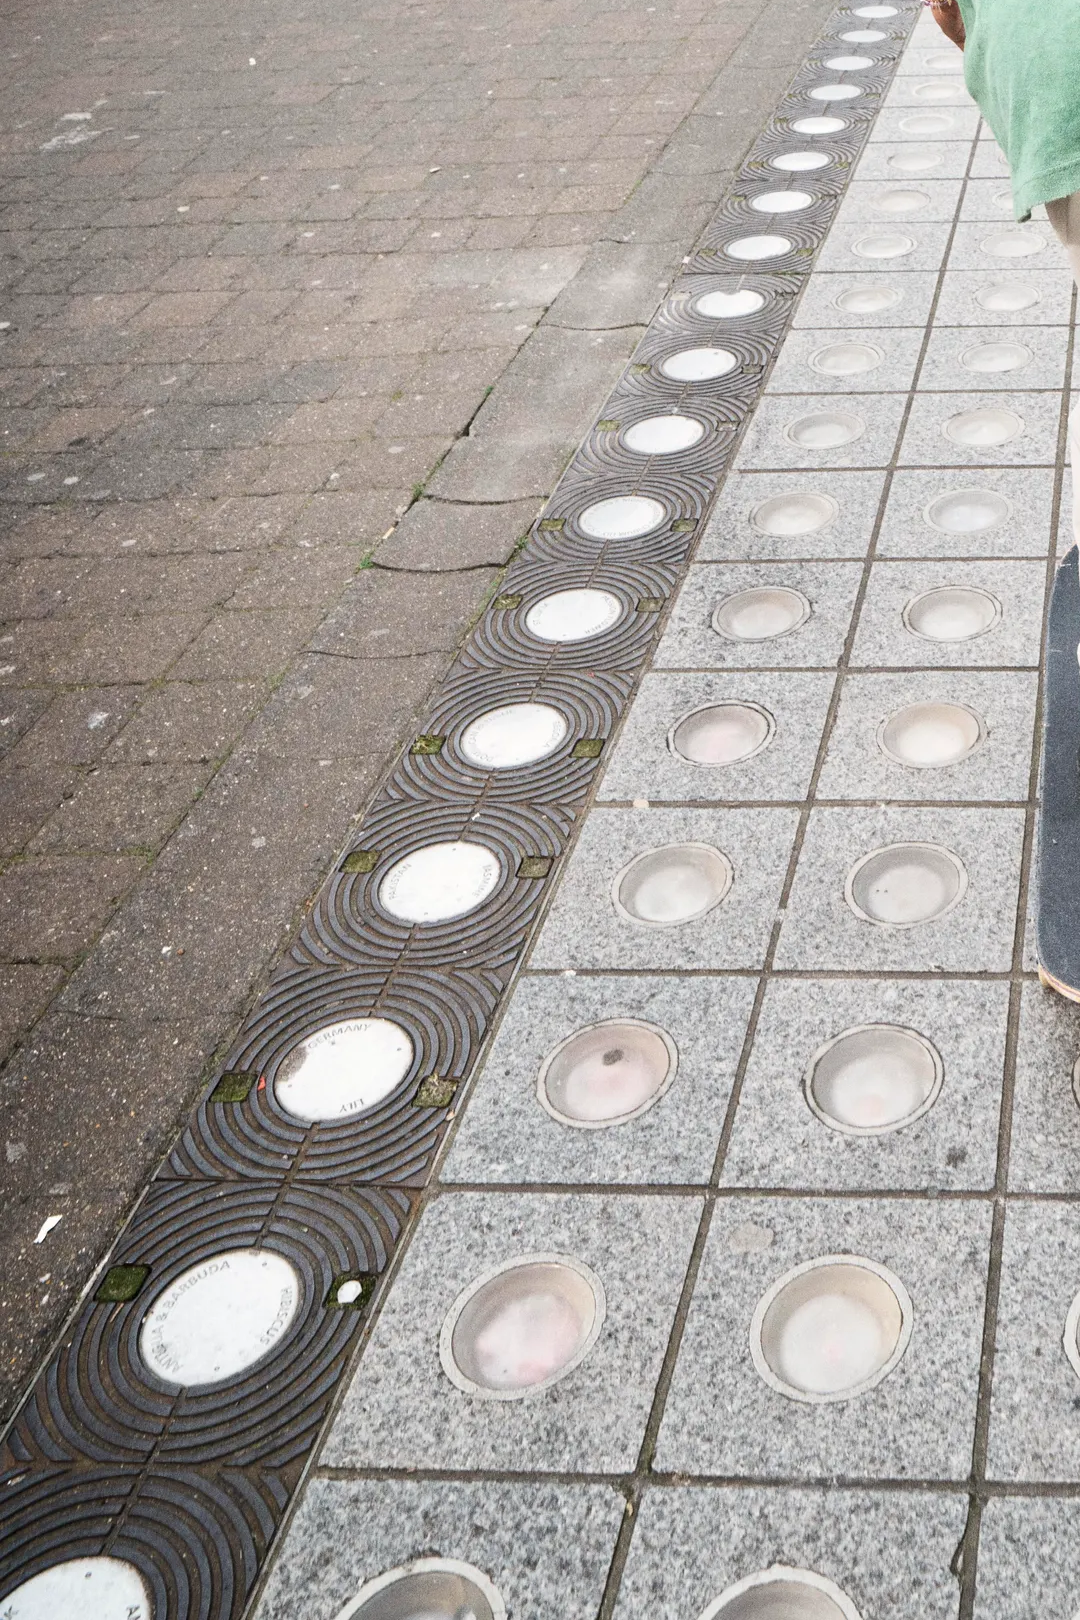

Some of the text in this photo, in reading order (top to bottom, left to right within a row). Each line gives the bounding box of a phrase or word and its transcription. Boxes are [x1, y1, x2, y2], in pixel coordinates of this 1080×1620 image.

[388, 863, 412, 900] PAKISTAN
[307, 1023, 372, 1049] GERMANY
[339, 1098, 365, 1113] LILY
[152, 1260, 231, 1374] ANTIGUA & BARBUDA
[260, 1284, 293, 1345] HIBISCUS
